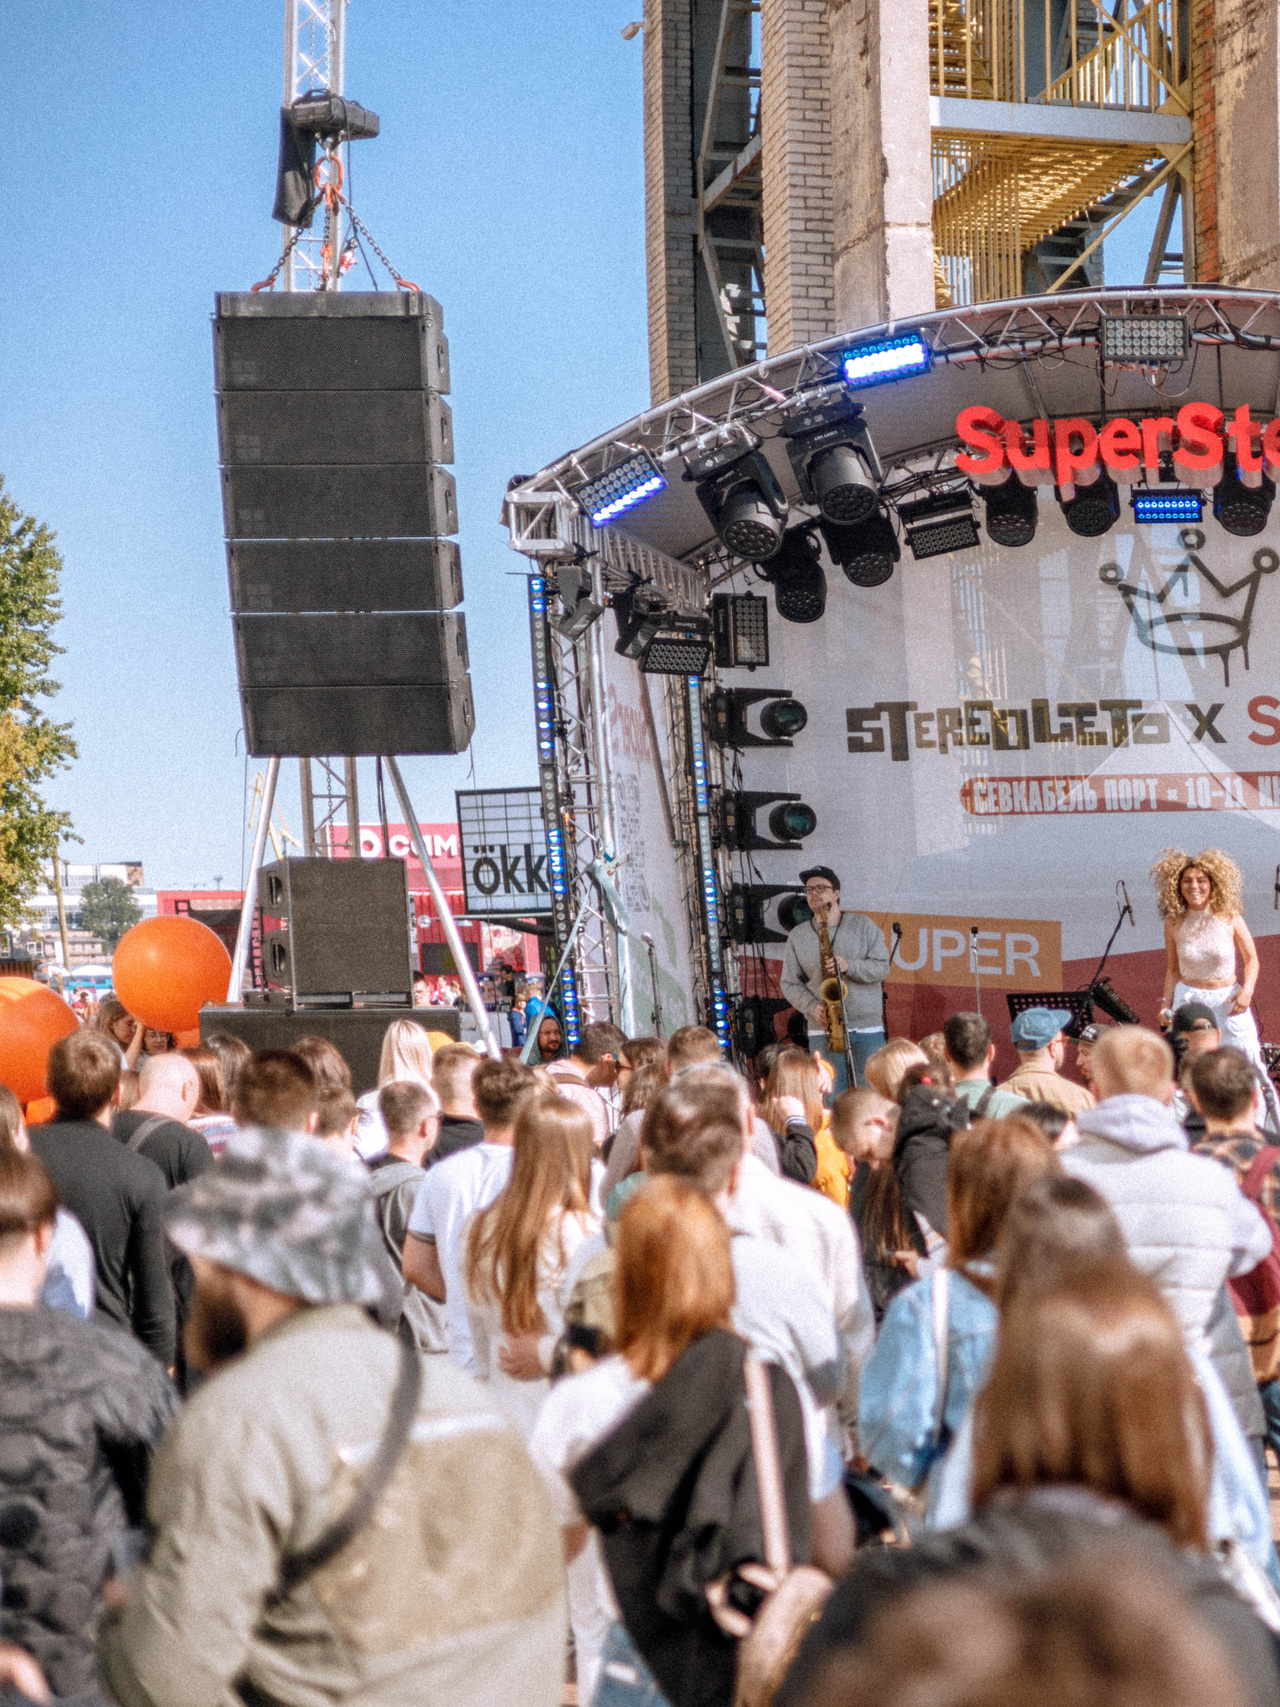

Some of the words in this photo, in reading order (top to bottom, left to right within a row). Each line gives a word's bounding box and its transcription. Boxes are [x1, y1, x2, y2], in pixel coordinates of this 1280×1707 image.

[972, 778, 1099, 814] СЕВКАБЕЛЬ
[1104, 778, 1158, 811] ПОРТ
[891, 927, 1042, 978] UPER
